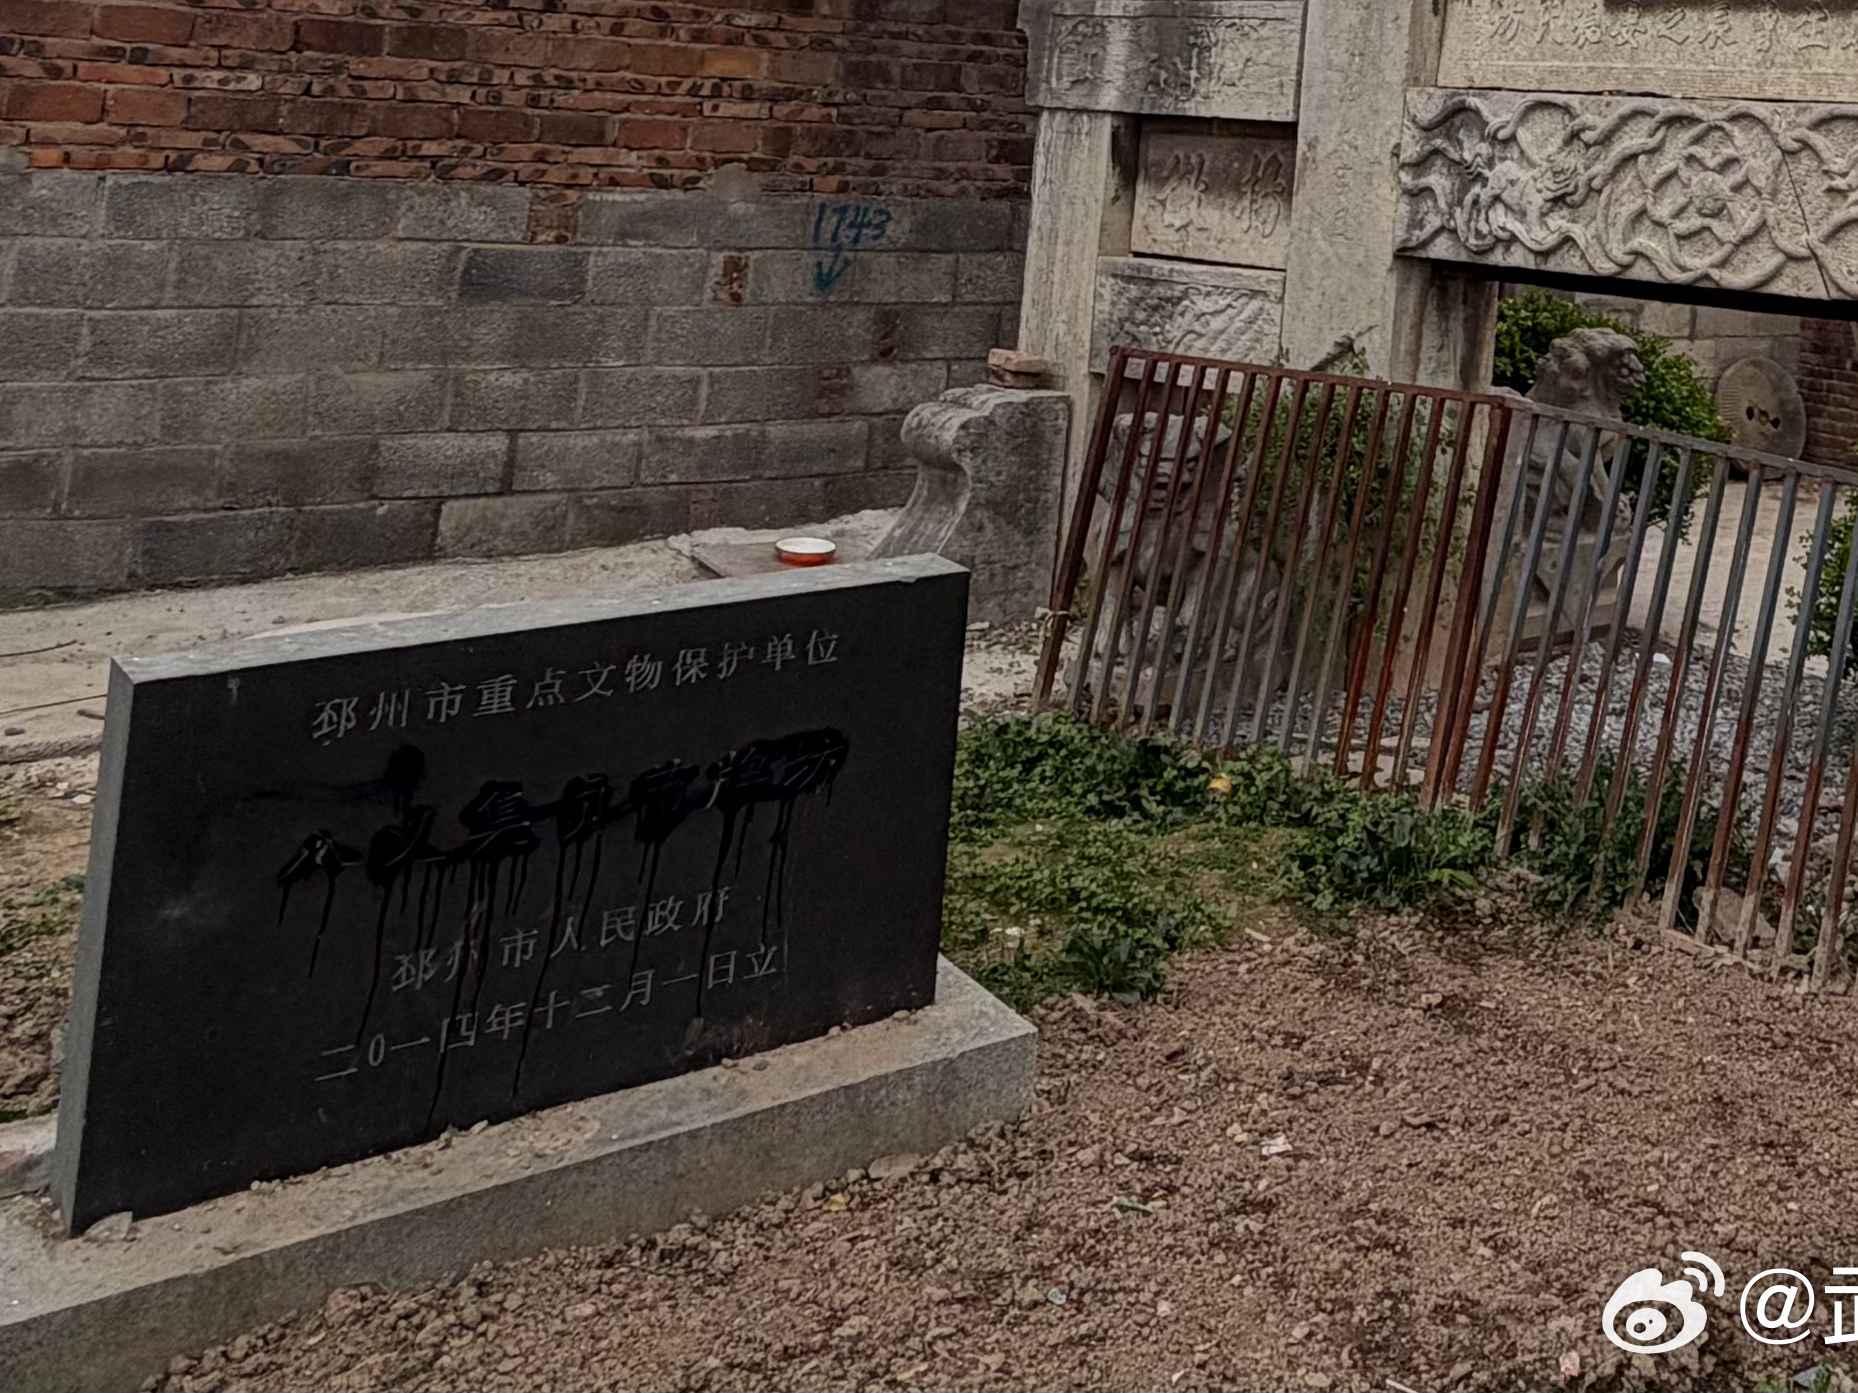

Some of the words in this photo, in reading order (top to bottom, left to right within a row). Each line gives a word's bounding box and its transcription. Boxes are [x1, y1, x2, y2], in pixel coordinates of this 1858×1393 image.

[312, 628, 842, 742] 邳州市重点文物保护单位
[390, 885, 732, 992] 邳州市人民政府
